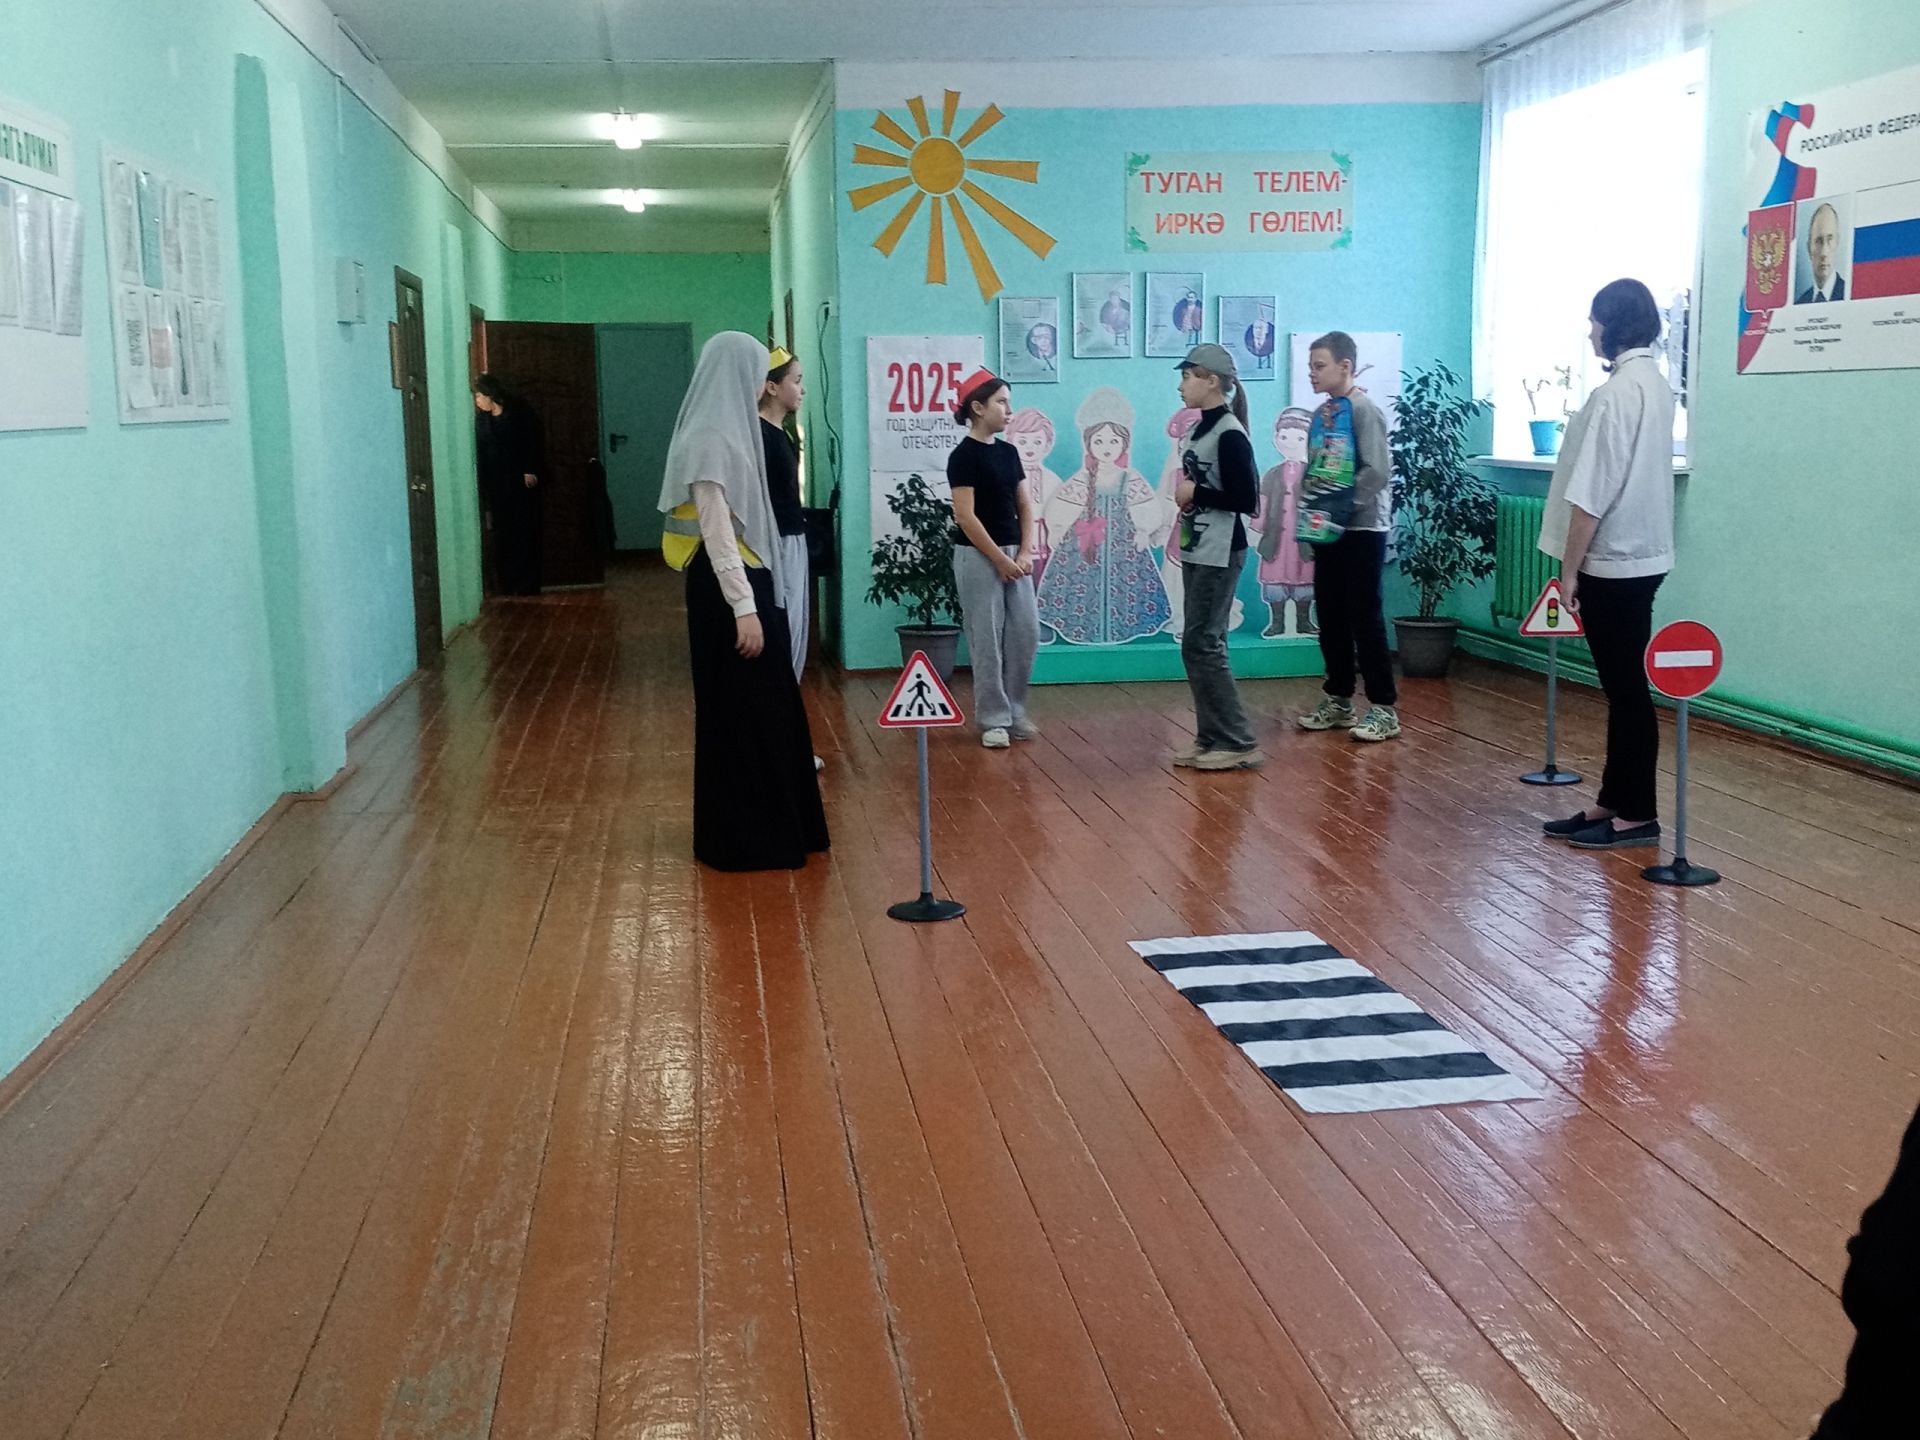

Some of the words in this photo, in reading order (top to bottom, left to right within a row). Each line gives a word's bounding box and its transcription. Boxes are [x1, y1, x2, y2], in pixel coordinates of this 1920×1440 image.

[1800, 123, 1872, 153] РОССИЙСКАЯ
[1140, 172, 1223, 193] ТУГАН
[1253, 171, 1348, 193] ТЕЛЕМ-
[1155, 213, 1225, 234] ИРКӘ
[1249, 208, 1343, 233] ГӨЛЕМ!
[888, 362, 963, 413] 2025
[887, 417, 907, 433] ГОД
[908, 417, 966, 433] ЗАЩИТНИ
[902, 435, 960, 449] ОТЕЧЕСТВА
